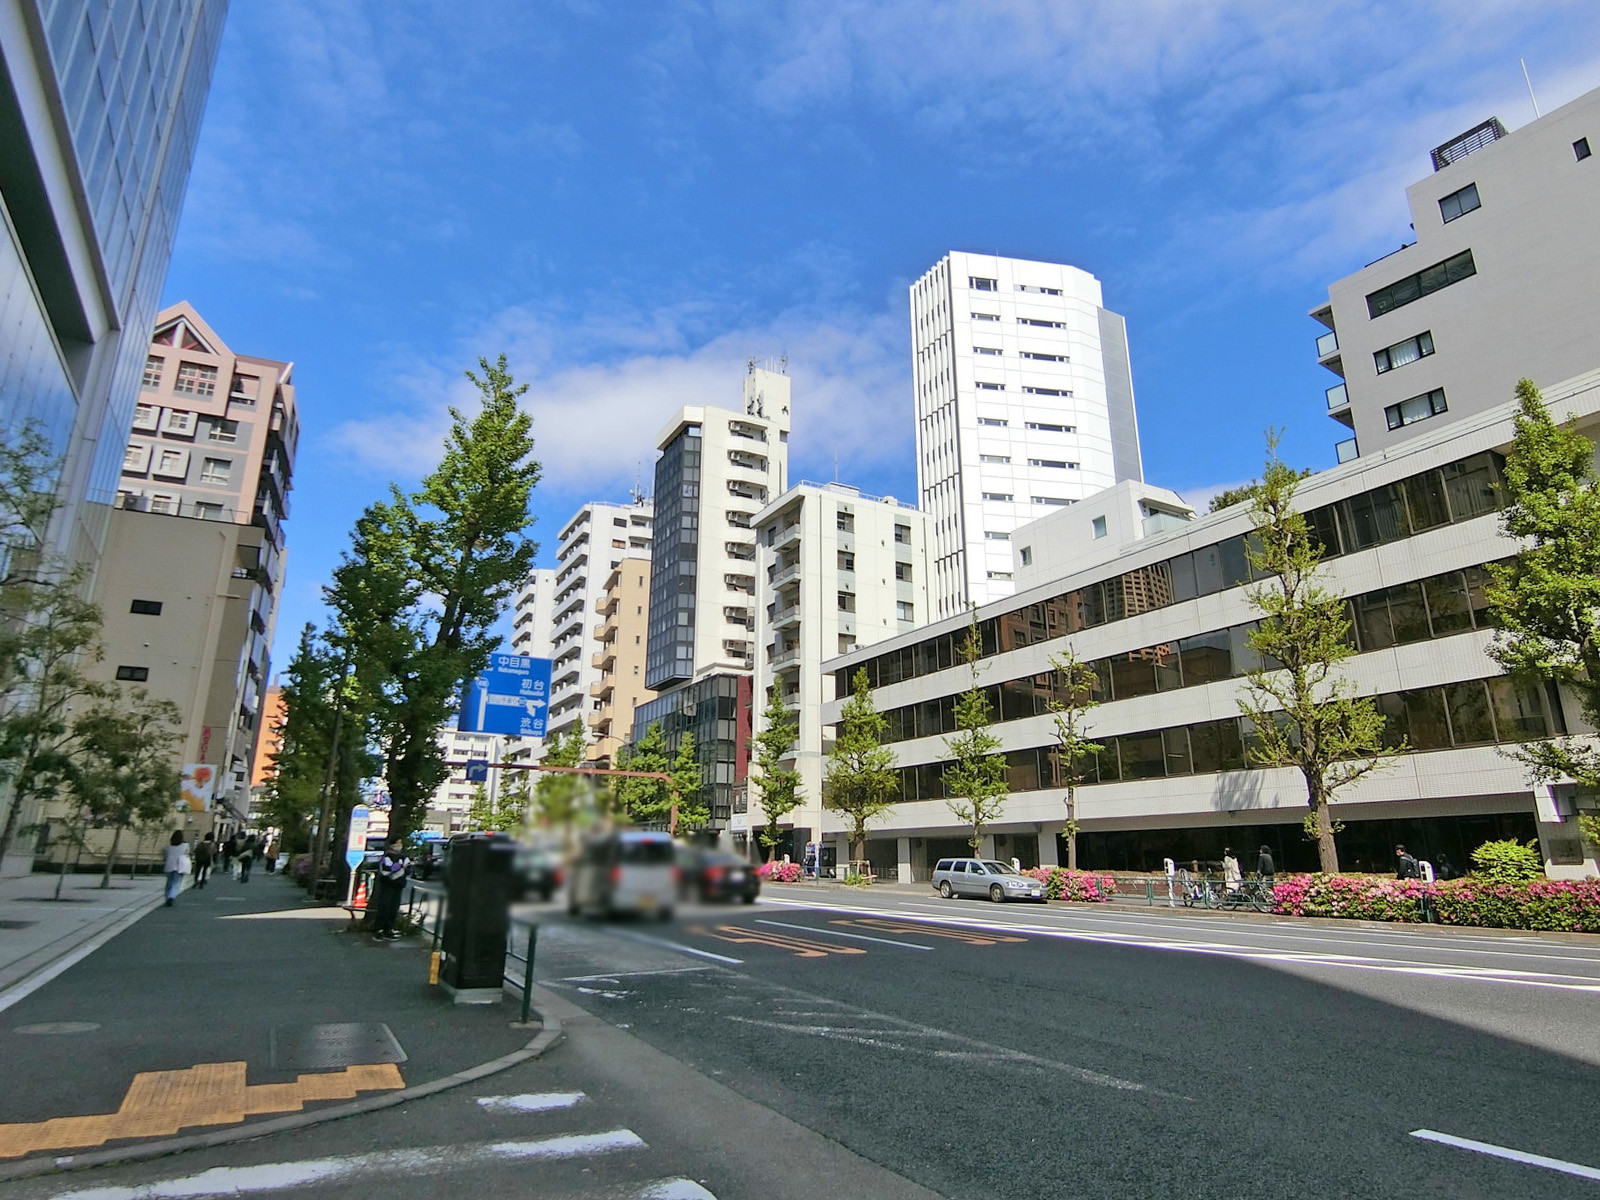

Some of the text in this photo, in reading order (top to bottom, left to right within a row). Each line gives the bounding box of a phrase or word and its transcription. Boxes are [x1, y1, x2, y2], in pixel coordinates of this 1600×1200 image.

[498, 656, 531, 669] 中目黒
[521, 678, 545, 690] 初台
[520, 717, 544, 729] 渋谷
